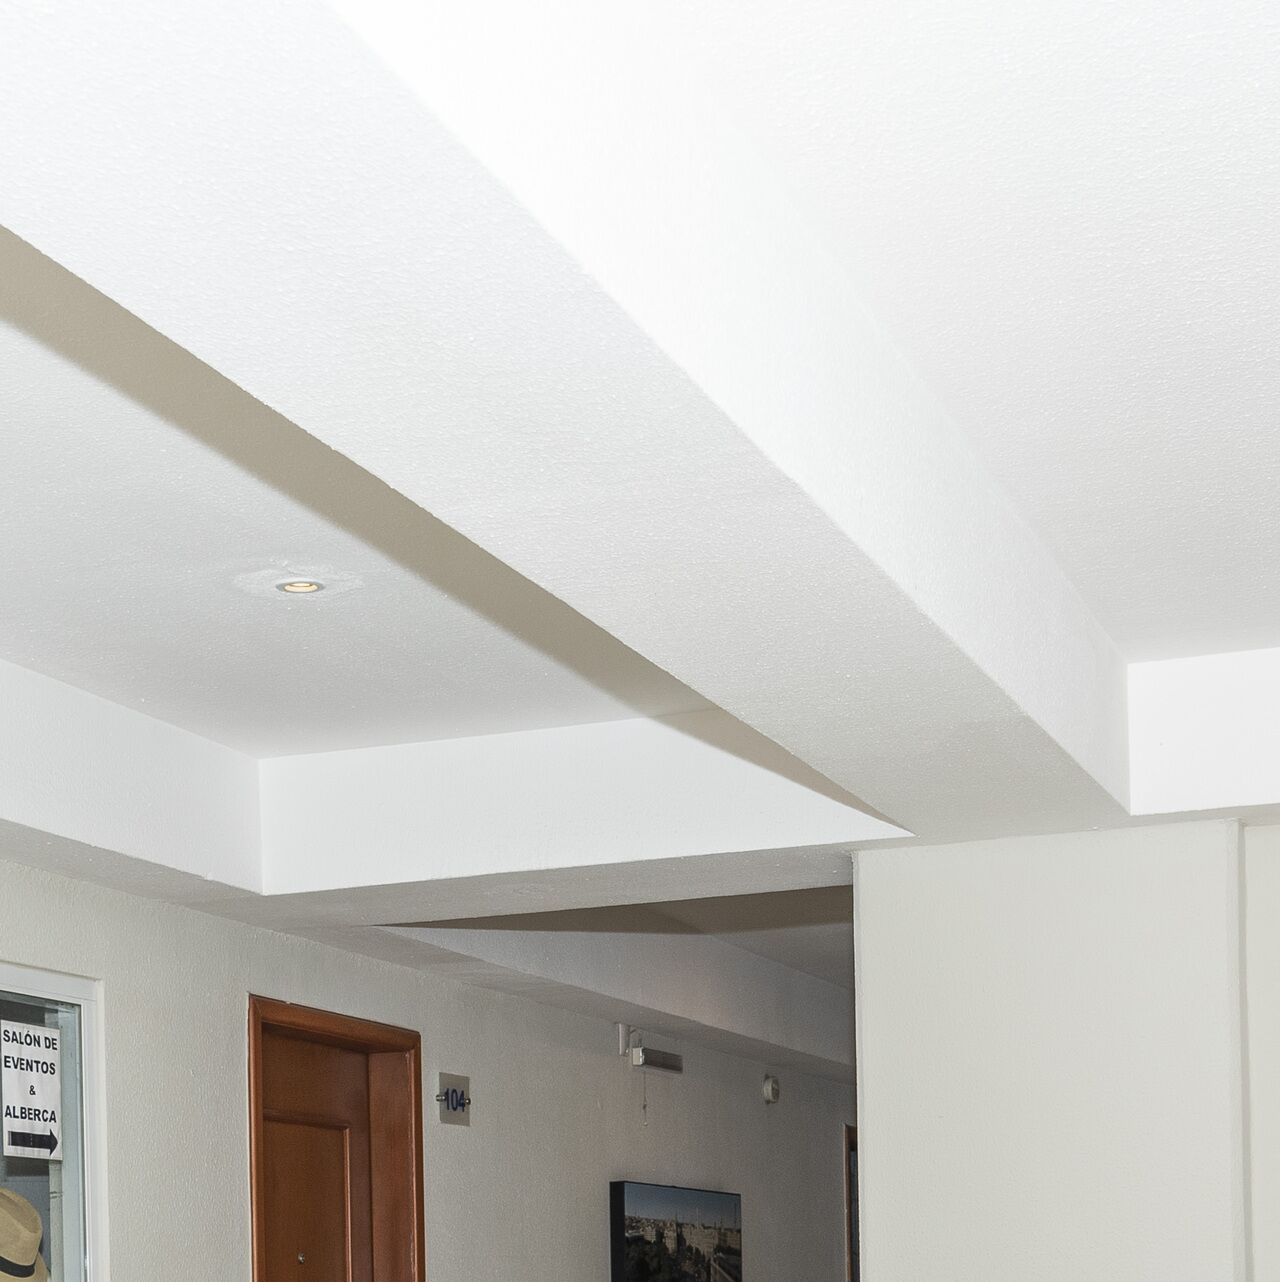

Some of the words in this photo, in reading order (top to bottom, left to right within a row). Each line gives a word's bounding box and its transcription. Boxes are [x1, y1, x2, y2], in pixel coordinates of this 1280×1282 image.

[2, 1029, 41, 1048] SALÓN
[44, 1036, 58, 1051] DE
[3, 1055, 56, 1075] EVENTOS
[29, 1085, 36, 1096] &
[443, 1087, 467, 1113] 104
[4, 1105, 57, 1123] ALBERCA
